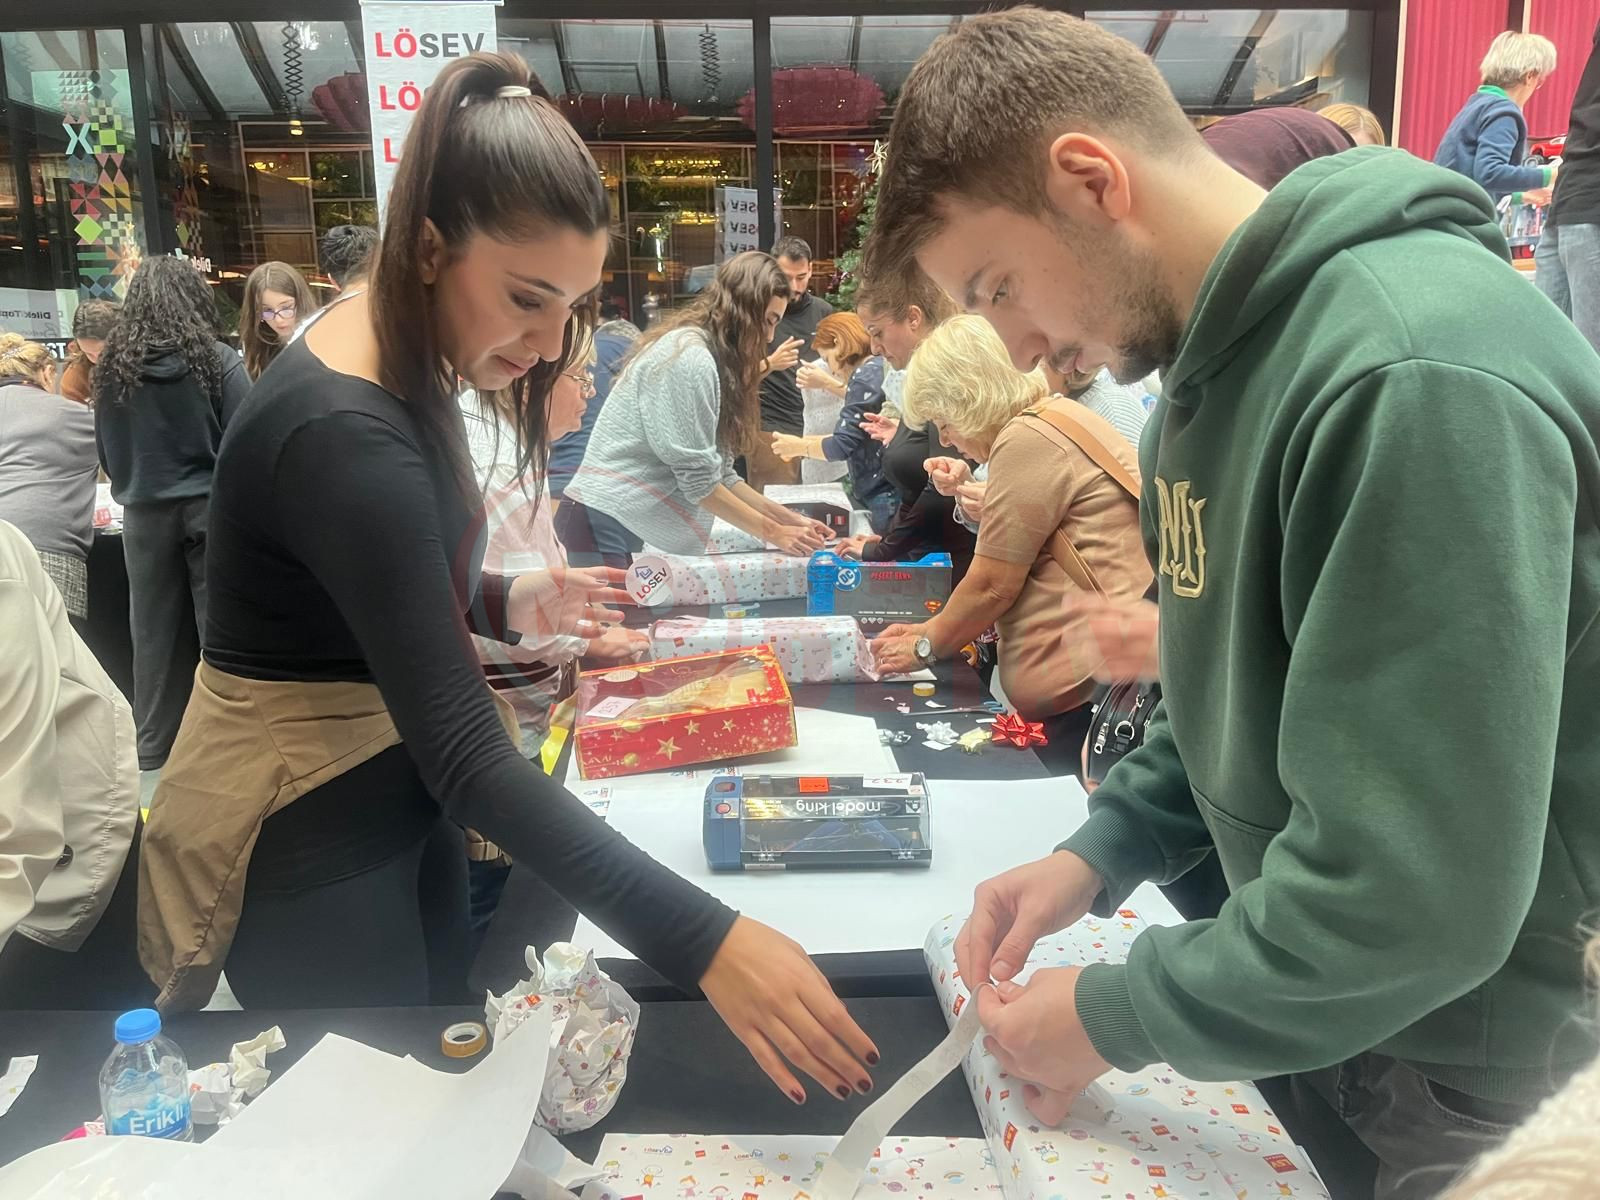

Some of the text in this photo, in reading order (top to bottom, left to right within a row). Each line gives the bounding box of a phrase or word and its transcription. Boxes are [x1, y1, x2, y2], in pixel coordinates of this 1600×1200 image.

[374, 28, 485, 58] LÖSEV
[379, 81, 426, 111] LÖ
[839, 569, 855, 584] DC
[796, 799, 831, 816] king
[832, 801, 881, 816] model
